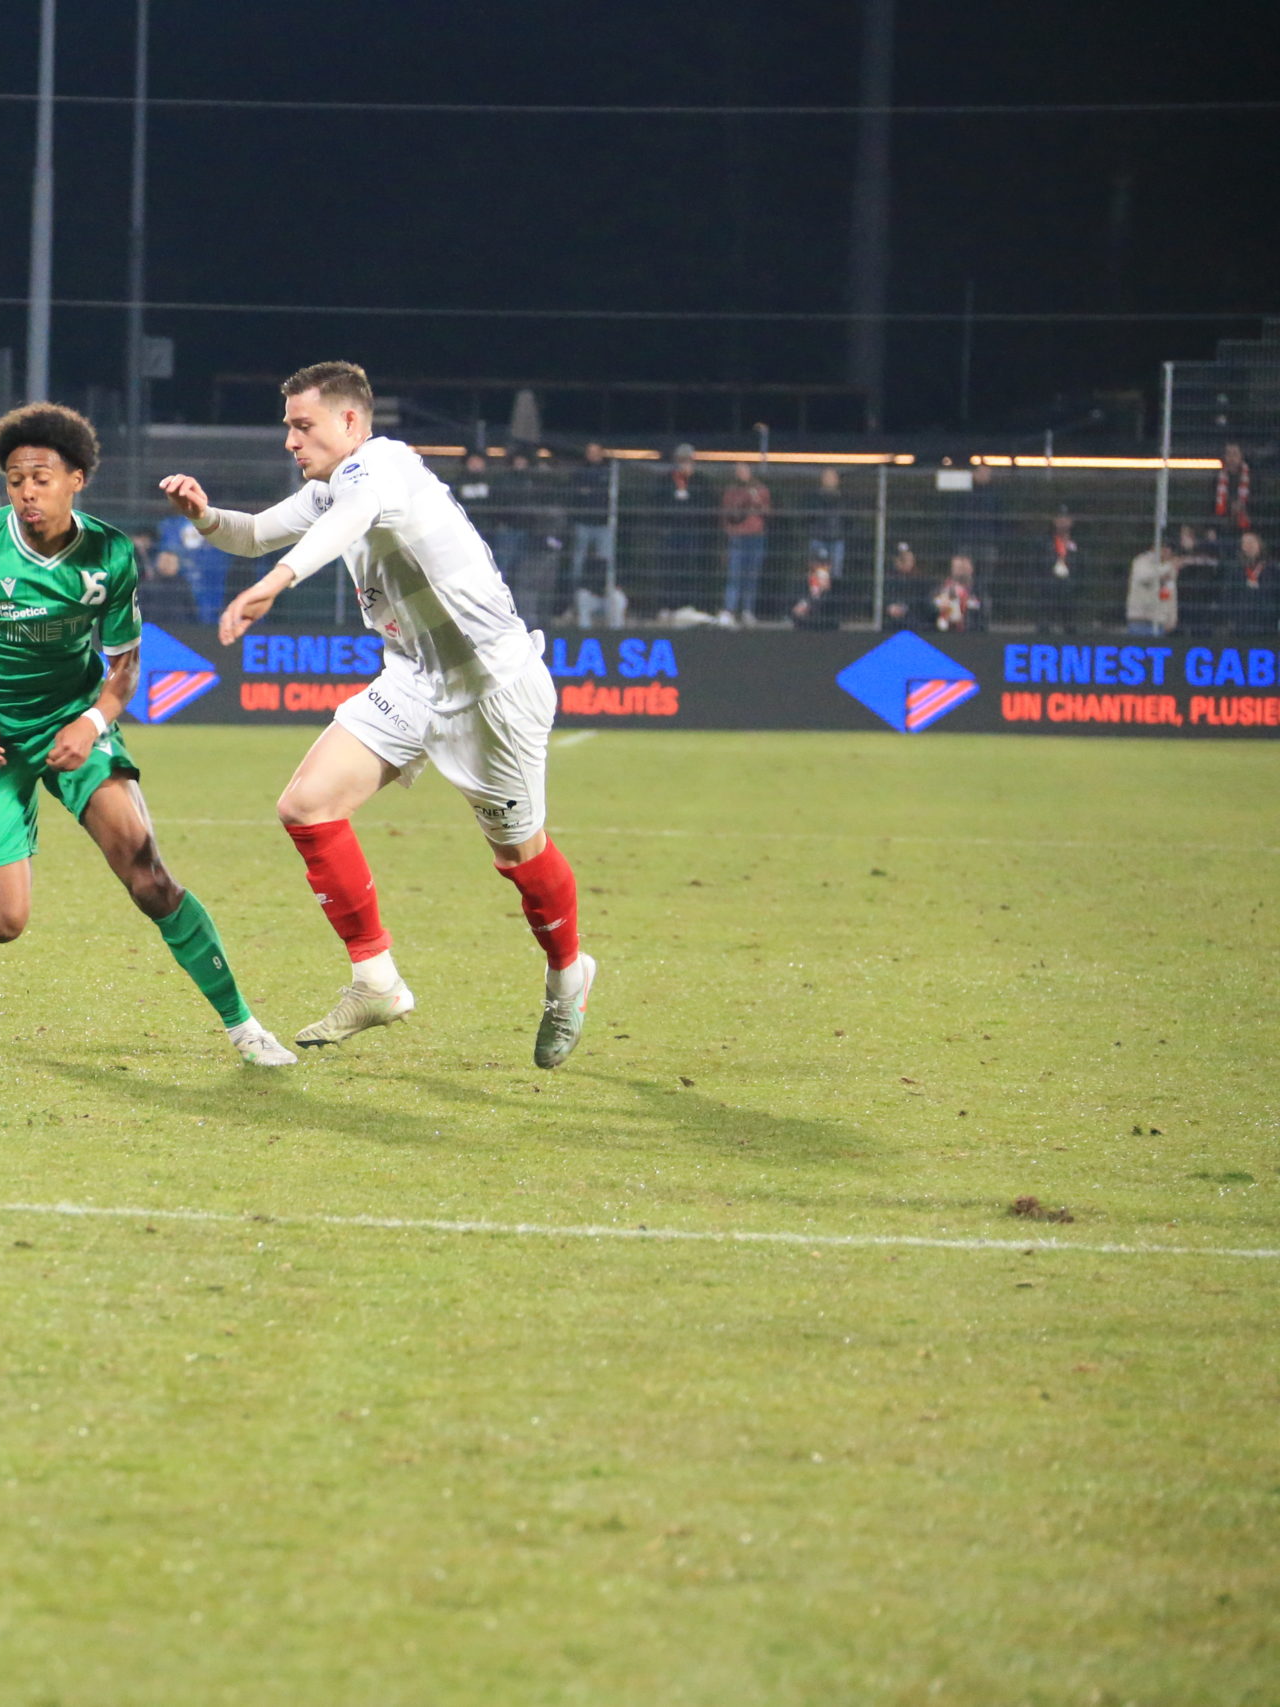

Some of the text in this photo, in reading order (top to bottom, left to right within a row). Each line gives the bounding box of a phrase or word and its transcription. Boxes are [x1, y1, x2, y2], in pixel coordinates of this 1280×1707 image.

[242, 635, 385, 675] ERNES
[618, 638, 679, 678] SA
[1004, 644, 1280, 687] ERNEST GAB
[240, 682, 280, 711] UN
[561, 680, 680, 715] RÉALITÉS
[1001, 691, 1042, 722] UN
[1046, 693, 1183, 726] CHANTIER,
[389, 713, 409, 731] AG
